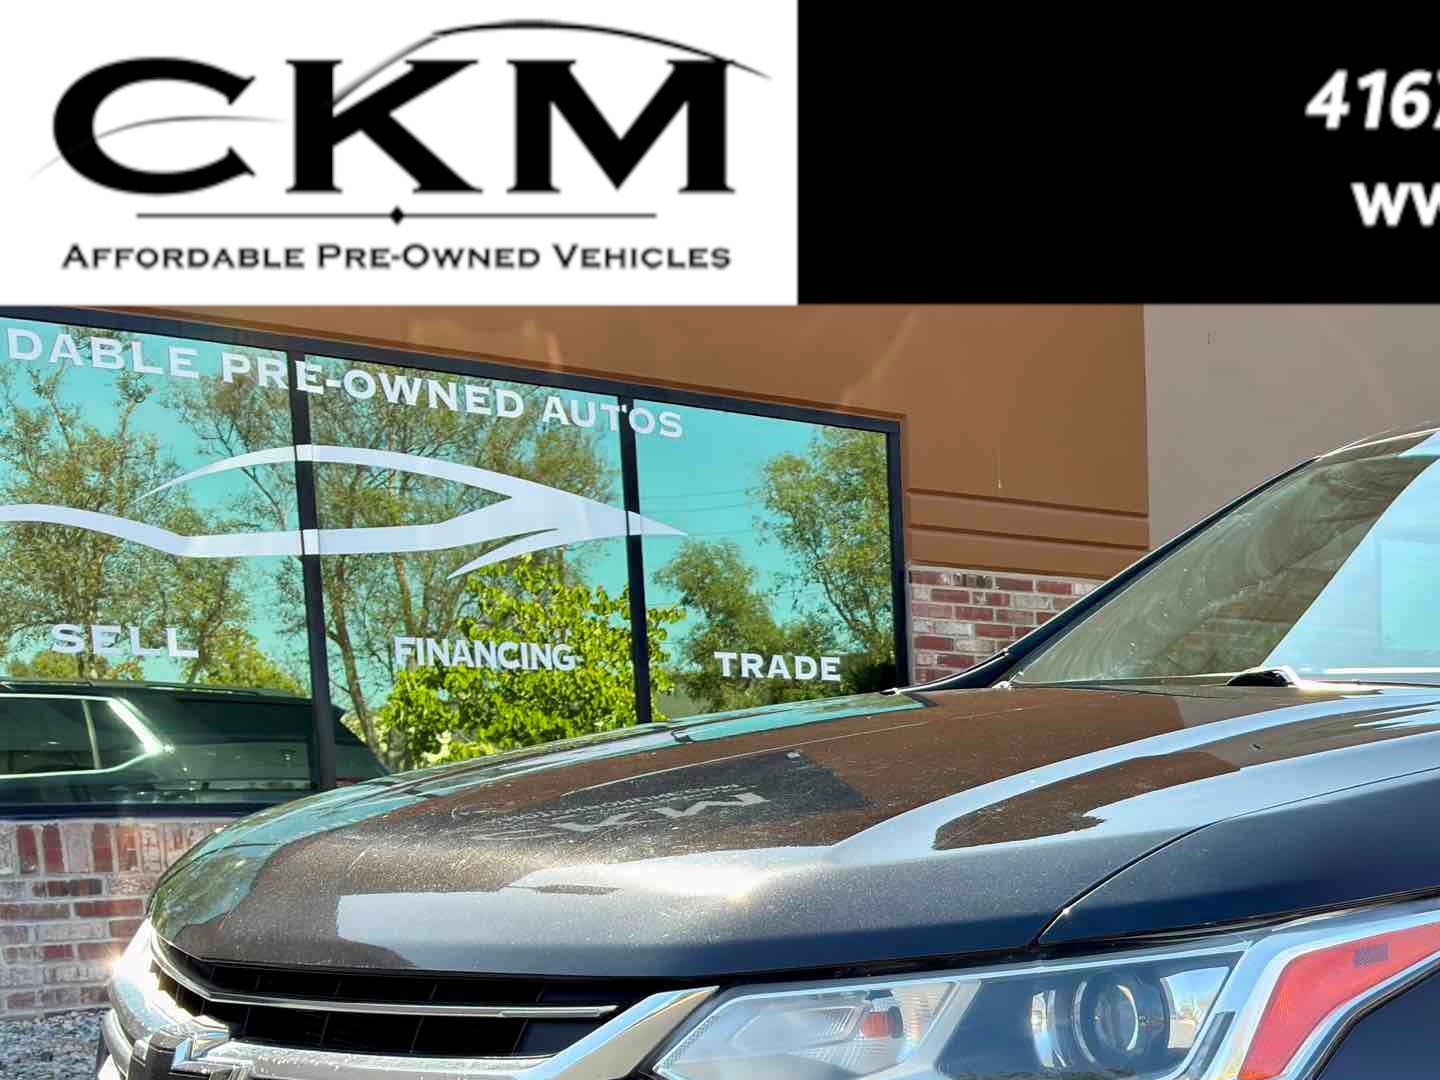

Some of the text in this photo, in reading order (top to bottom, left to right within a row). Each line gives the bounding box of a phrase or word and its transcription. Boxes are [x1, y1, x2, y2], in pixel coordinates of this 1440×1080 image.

[6, 328, 683, 438] DABLE PRE-OWNED AUTOS
[50, 623, 199, 658] SELL
[394, 636, 577, 672] FINANCING
[714, 651, 841, 682] TRADE
